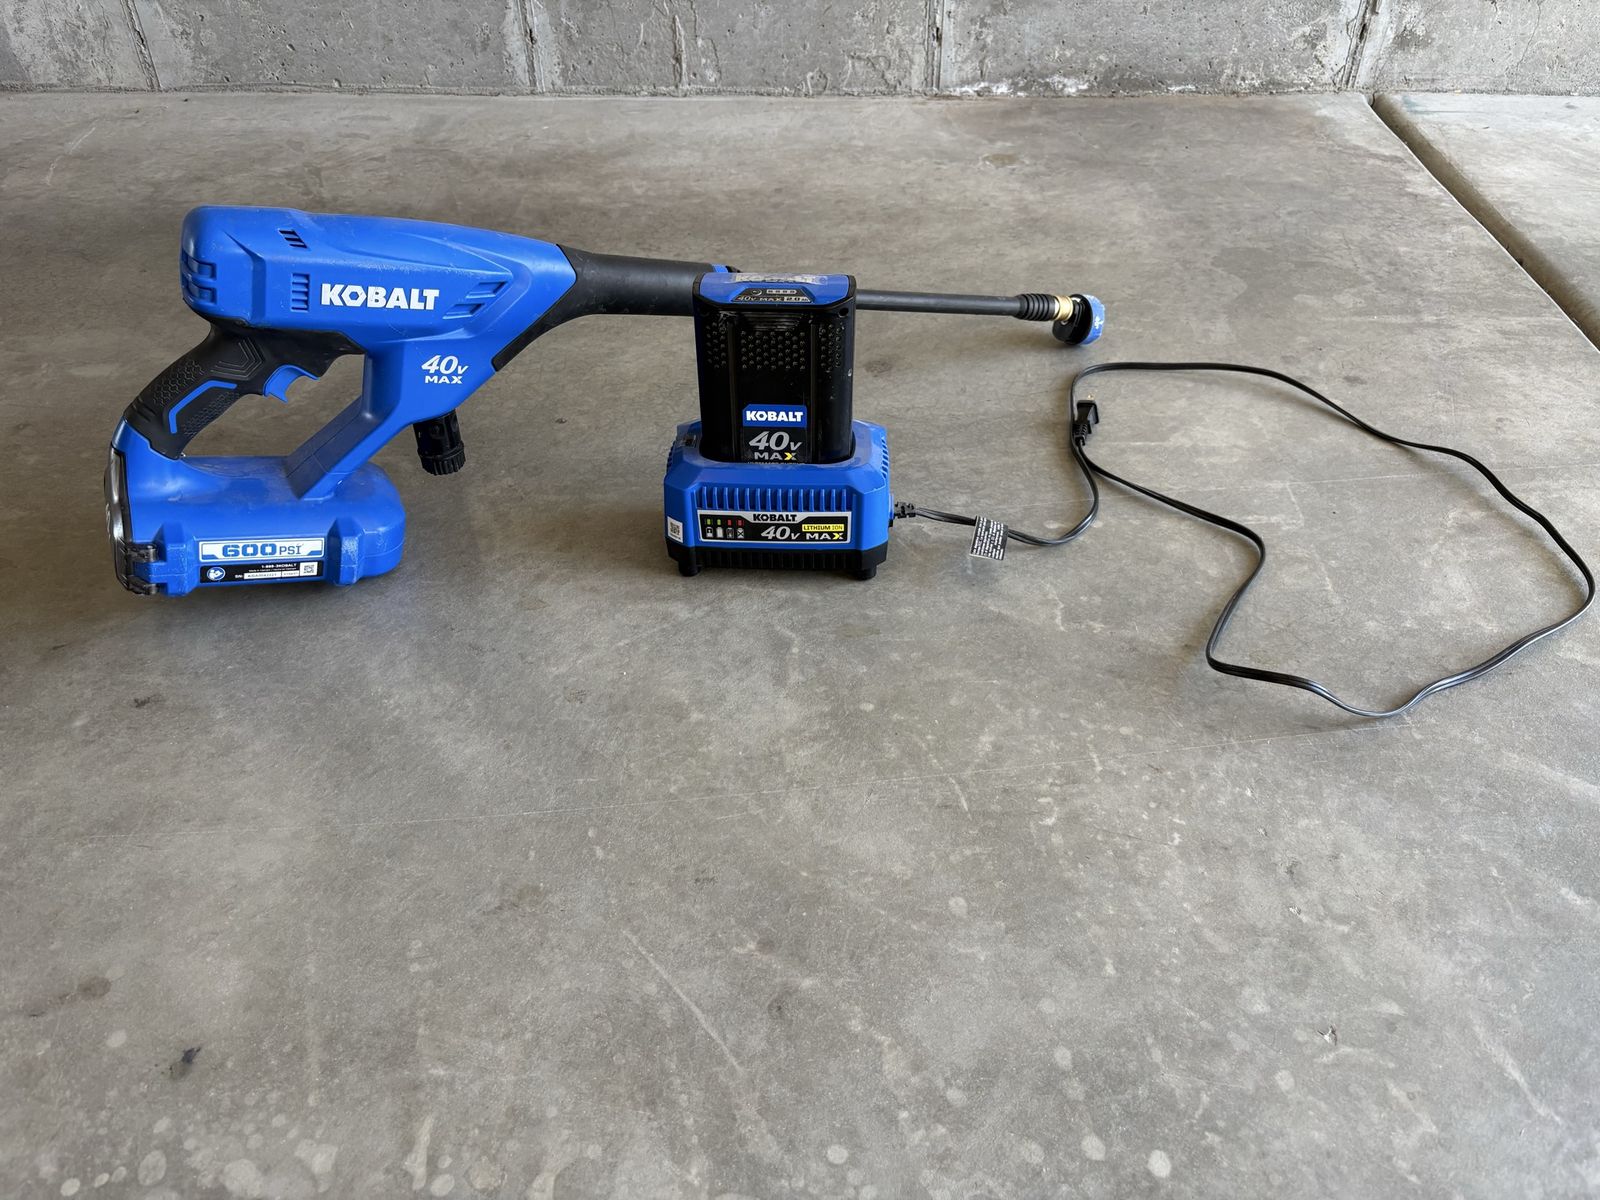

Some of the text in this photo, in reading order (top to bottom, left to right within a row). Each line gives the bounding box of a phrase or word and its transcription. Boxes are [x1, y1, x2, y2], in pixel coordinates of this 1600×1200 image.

[321, 283, 440, 311] KOBALT
[424, 375, 463, 384] MAX
[746, 410, 804, 422] KOBALT
[754, 452, 797, 460] MAX
[752, 513, 798, 522] KOBALT
[805, 532, 844, 540] MAX
[222, 543, 302, 558] 600 PSI
